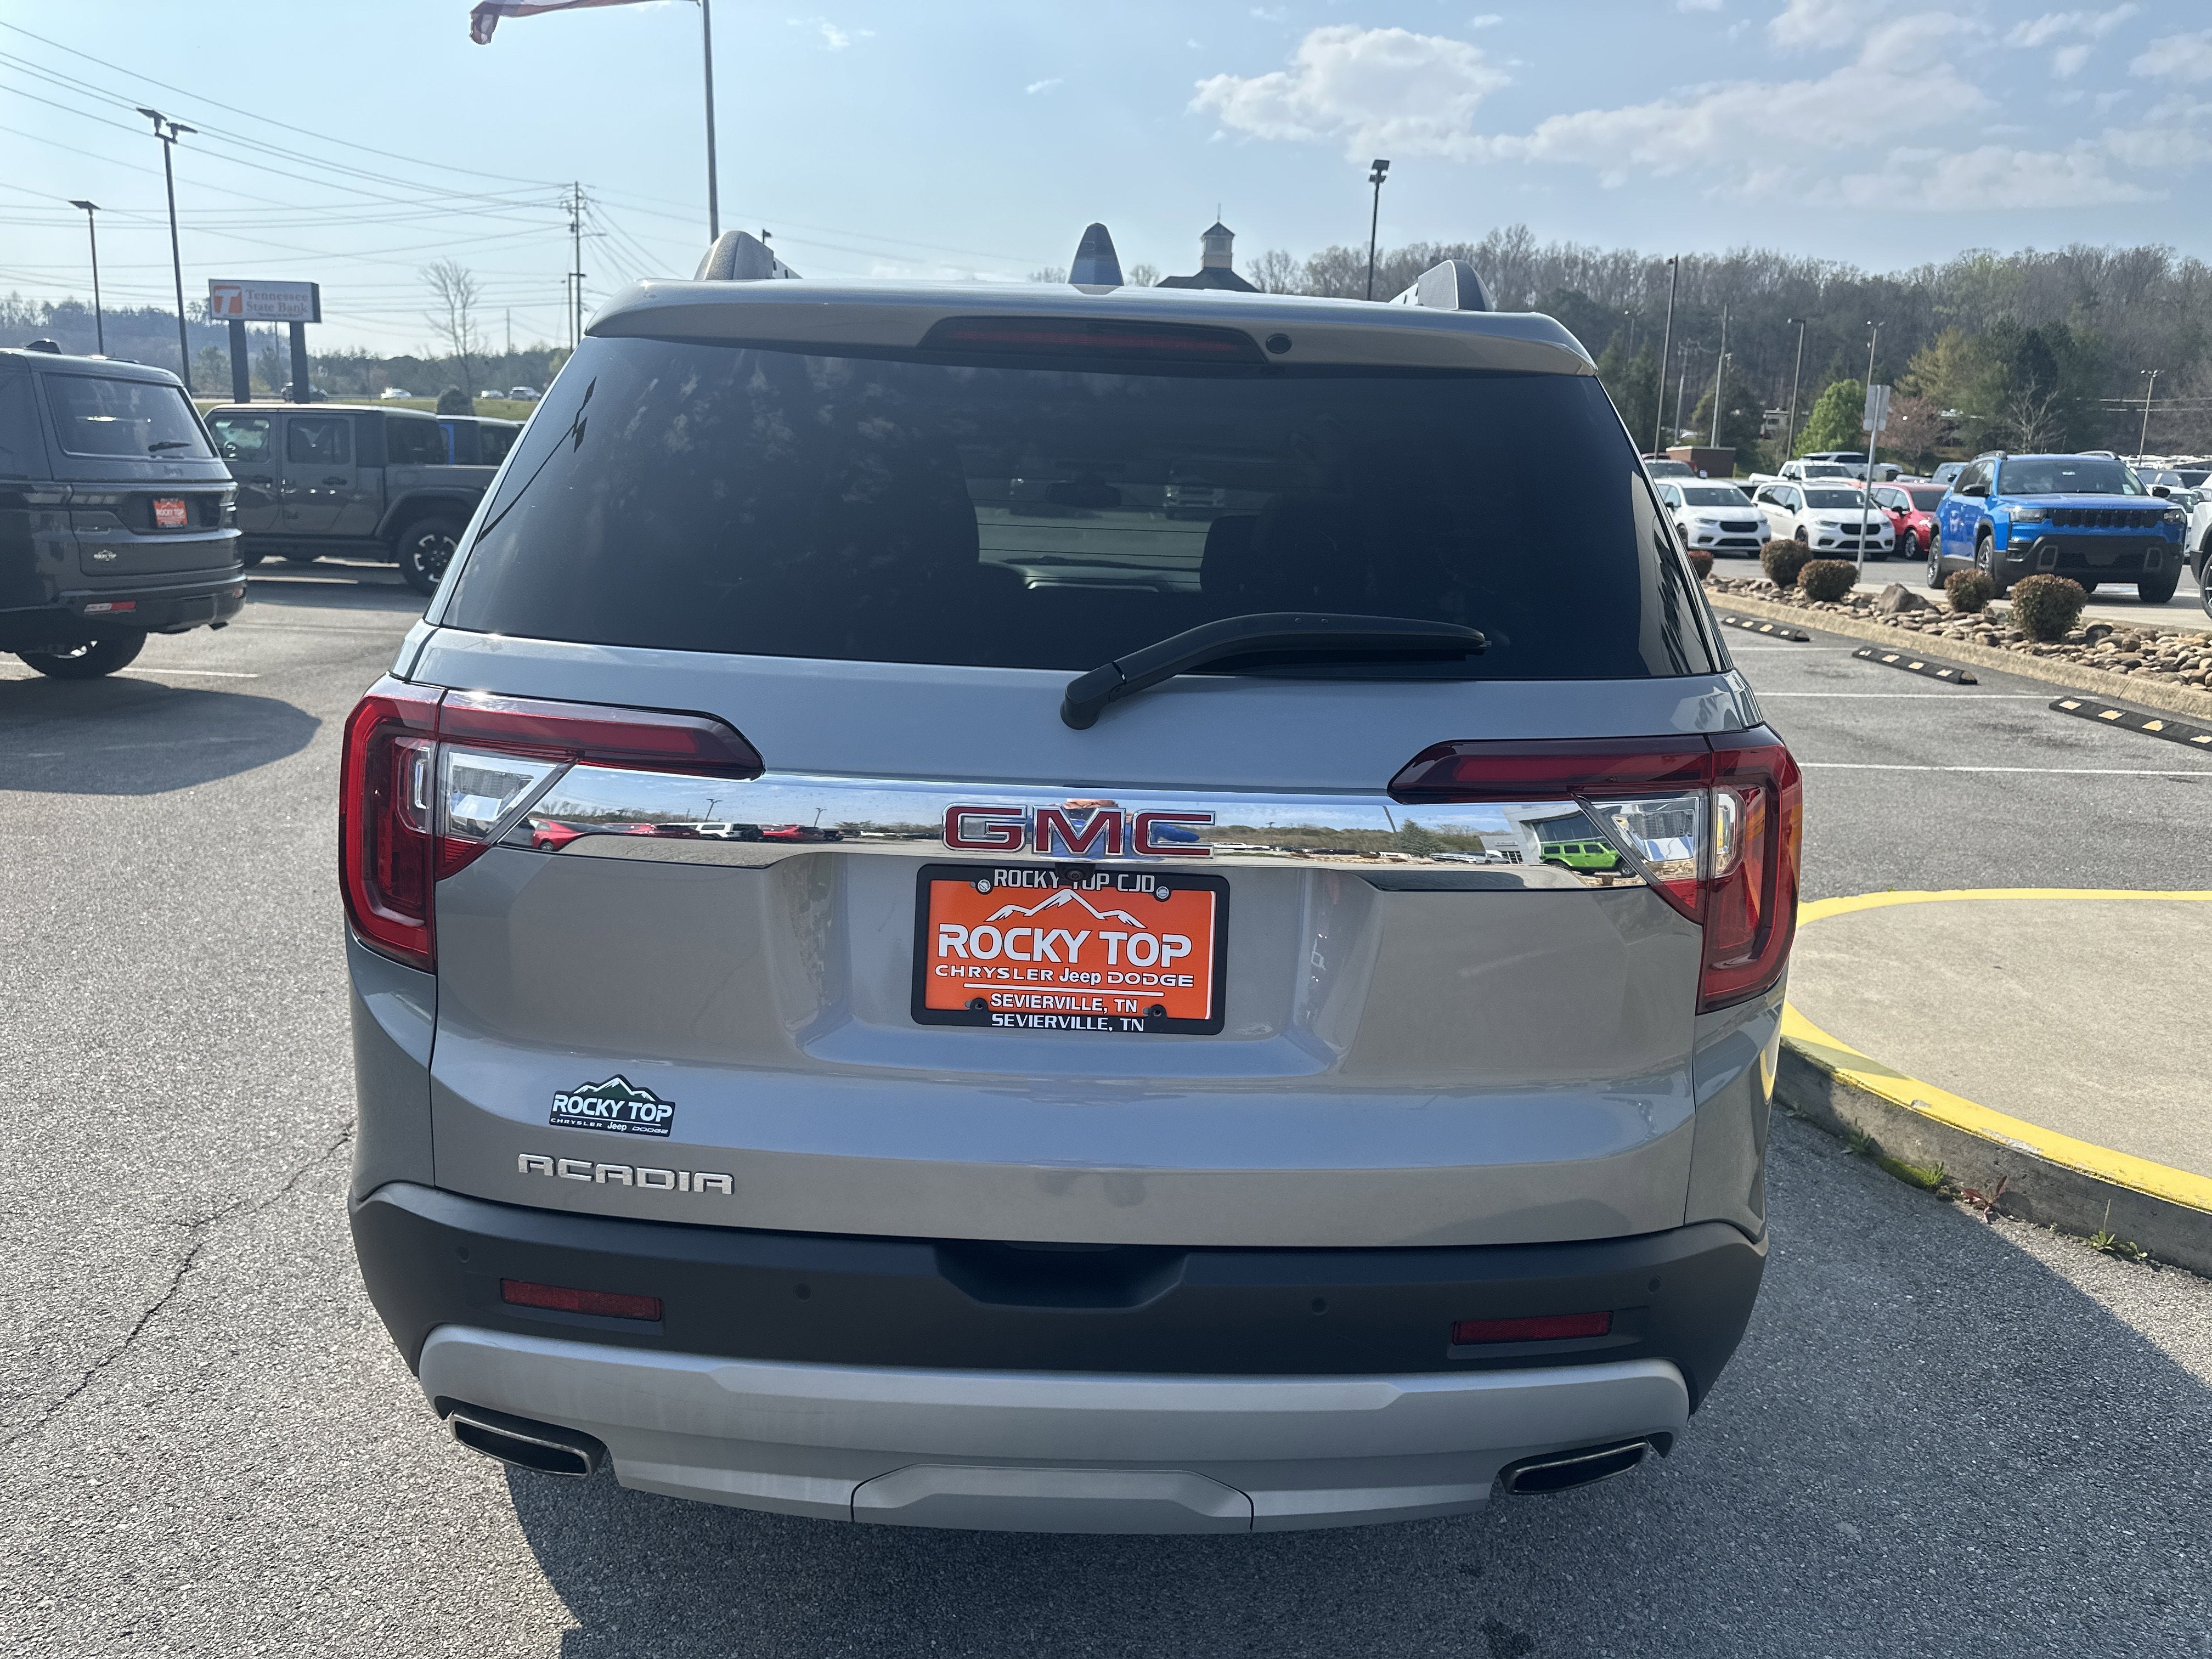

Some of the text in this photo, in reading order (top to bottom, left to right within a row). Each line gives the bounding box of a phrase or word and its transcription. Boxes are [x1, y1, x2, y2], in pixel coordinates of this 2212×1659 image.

[246, 290, 308, 301] Tennessee
[246, 302, 308, 313] State Bank
[941, 803, 1215, 859] GMC
[994, 869, 1059, 889] ROCKY
[1117, 874, 1155, 893] CJD
[938, 923, 1192, 968] ROCKY TOP
[935, 964, 1194, 988] CHRYSLER Jeep DODGE
[990, 993, 1138, 1014] SEVIERVILLE, TN
[991, 1013, 1144, 1032] SEVIERVILLE, TN
[552, 1094, 673, 1122] ROCKY TOP
[550, 1118, 669, 1134] CHRYSLER Jeep DODGE
[517, 1153, 734, 1194] ACADIA
